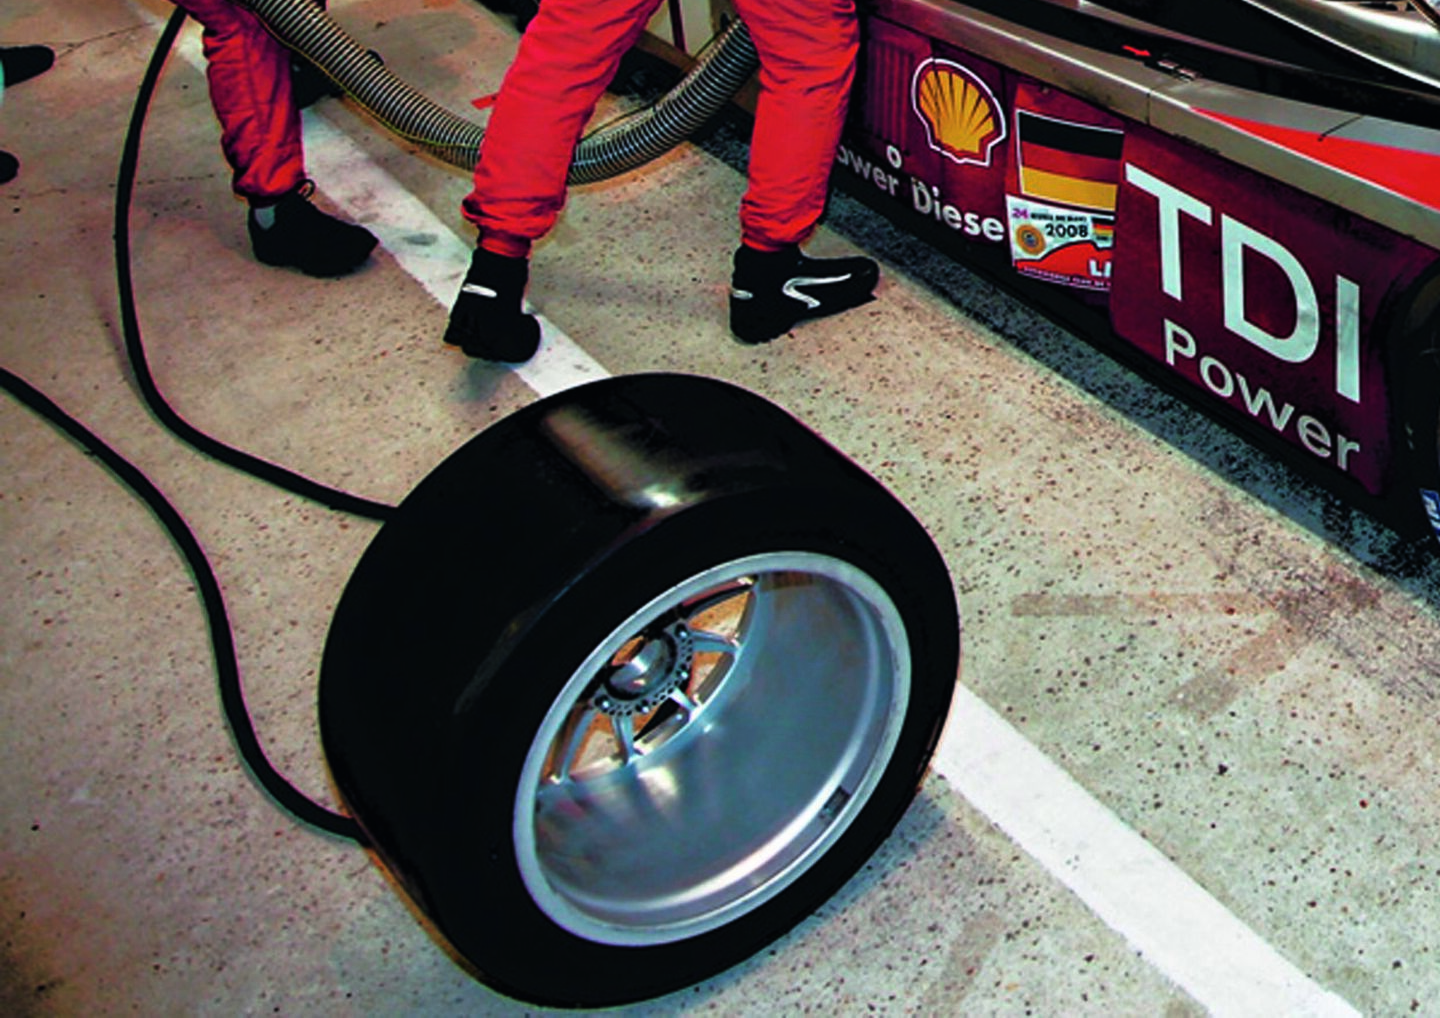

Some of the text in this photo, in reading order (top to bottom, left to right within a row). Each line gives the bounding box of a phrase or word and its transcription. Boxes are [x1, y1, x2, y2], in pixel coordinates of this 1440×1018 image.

[1045, 223, 1088, 238] 2008
[1125, 161, 1361, 405] TDI
[1163, 318, 1361, 472] Power
